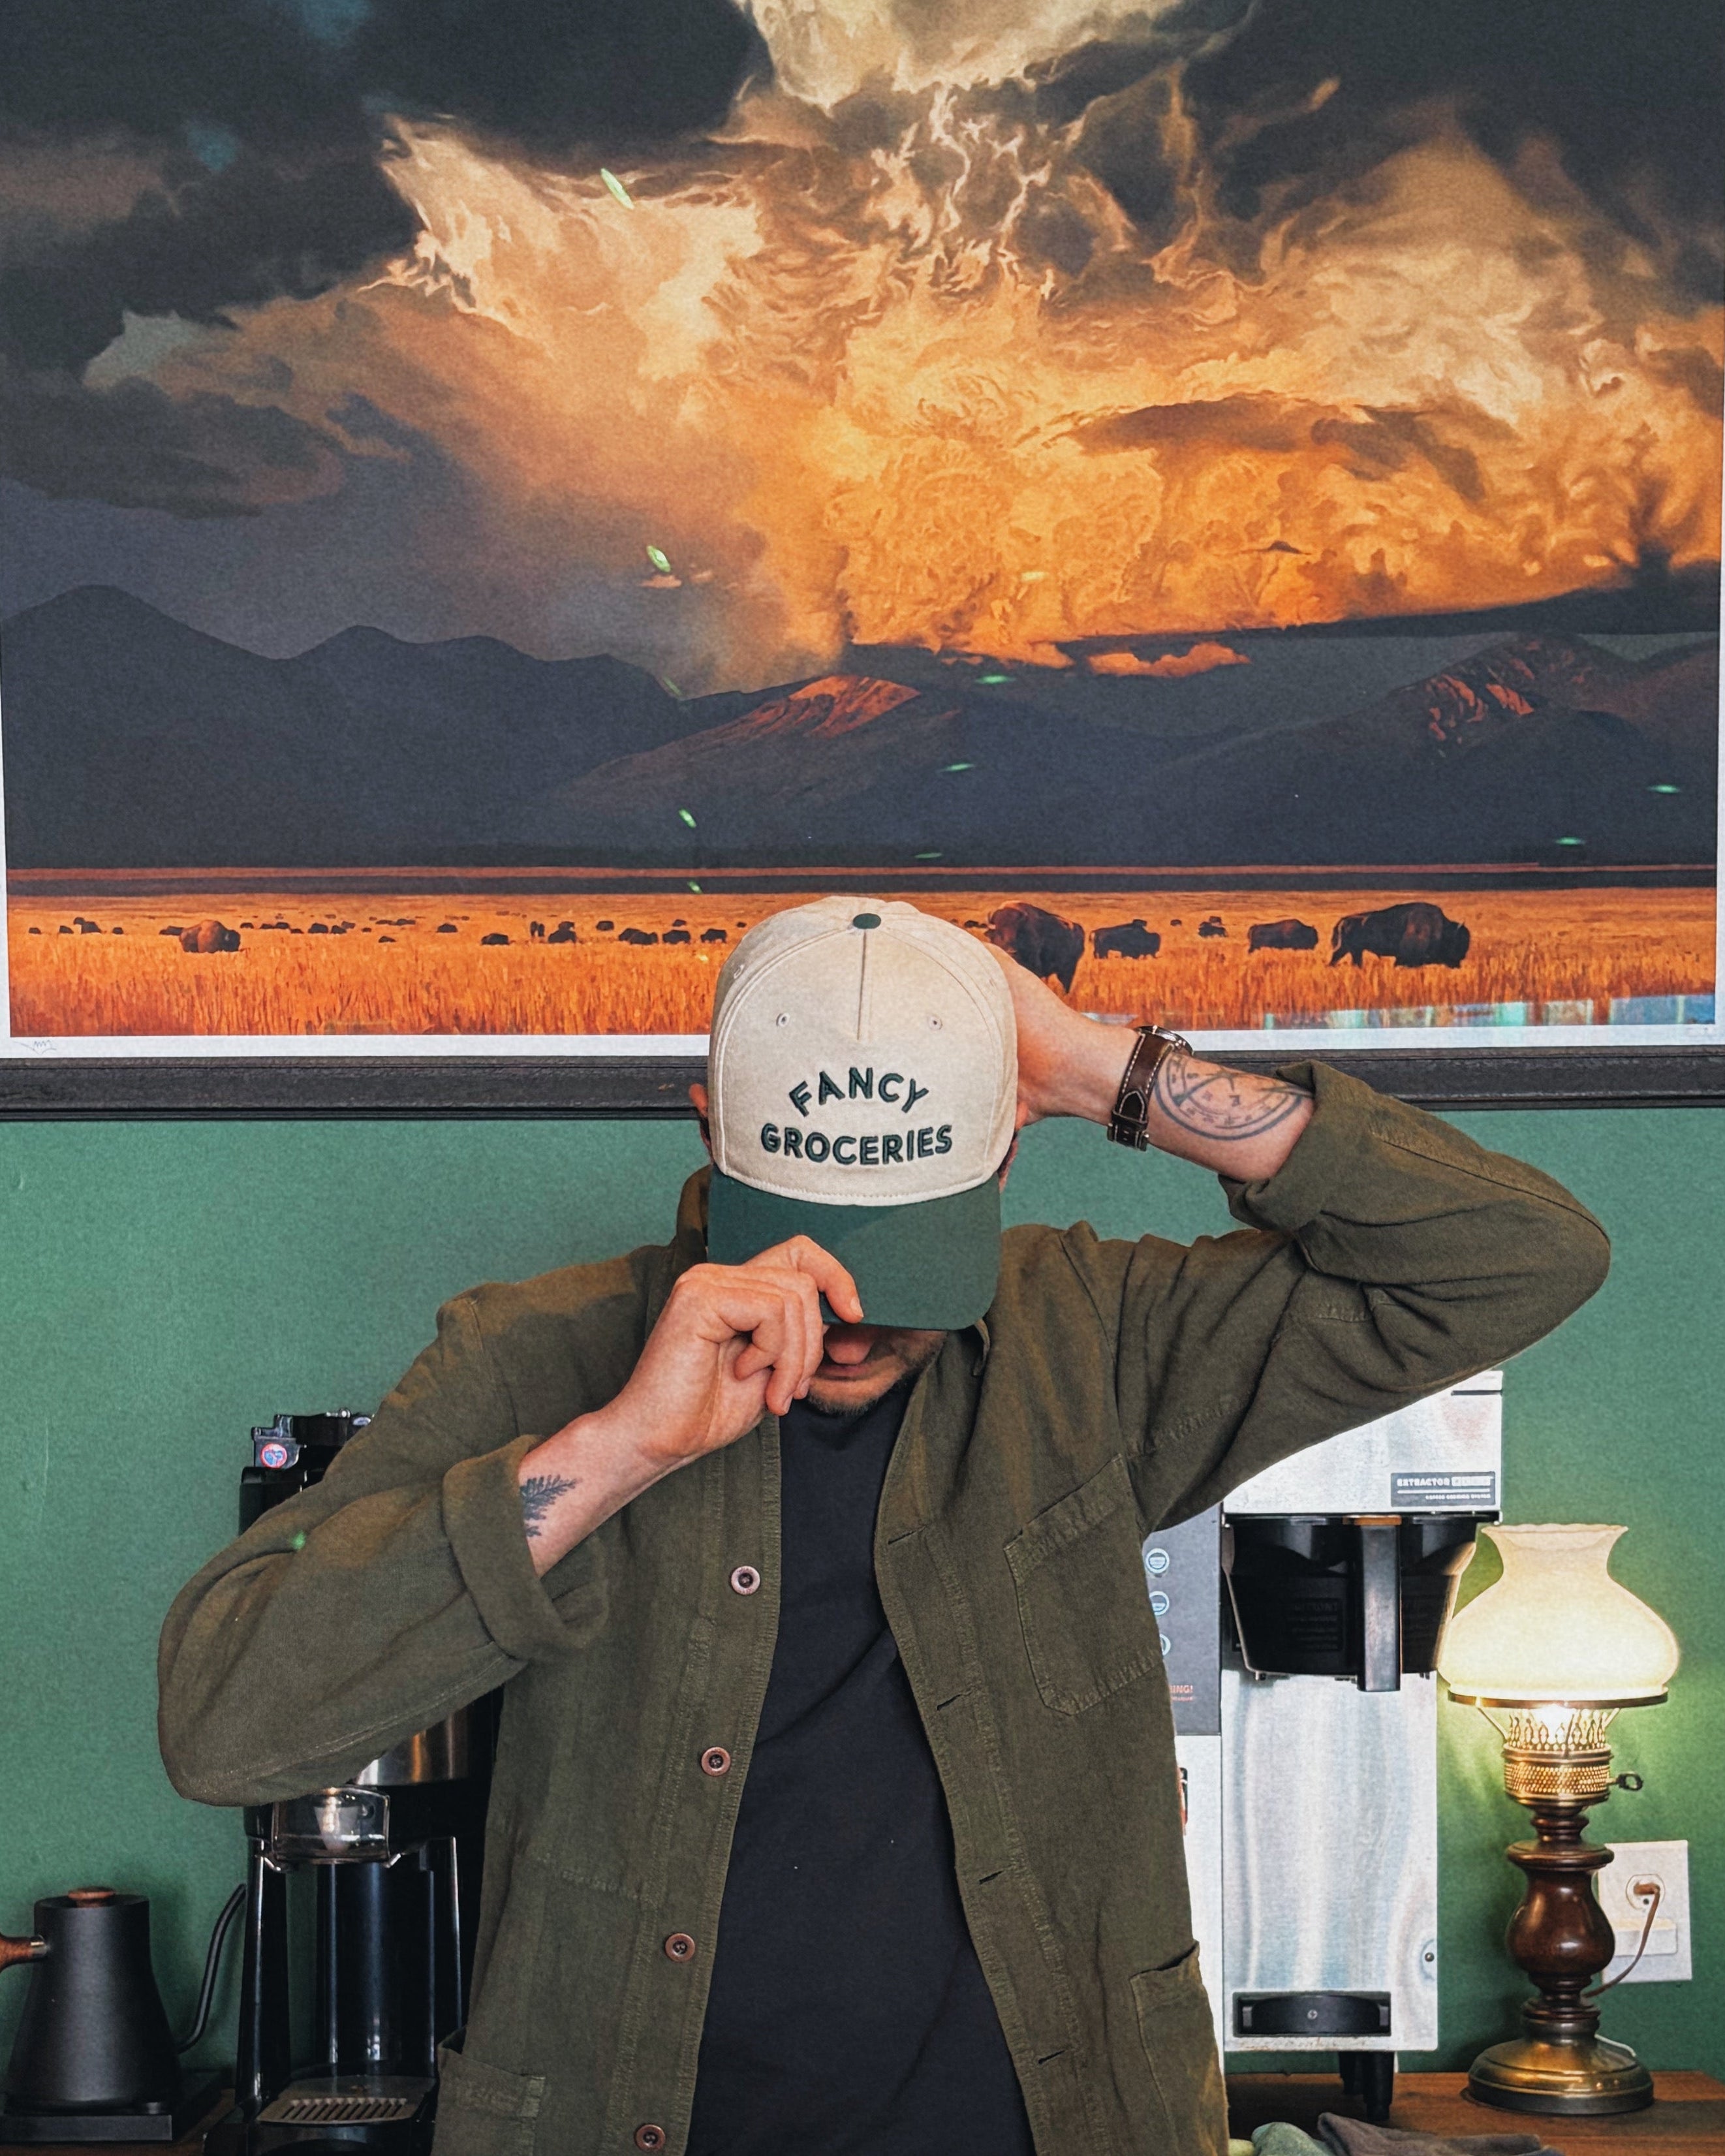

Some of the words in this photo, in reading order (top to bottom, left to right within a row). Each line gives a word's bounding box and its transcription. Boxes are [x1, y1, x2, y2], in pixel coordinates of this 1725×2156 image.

[788, 1067, 929, 1117] FANCY
[760, 1122, 953, 1165] GROCERIES
[1396, 1477, 1450, 1487] EXTRACTOR
